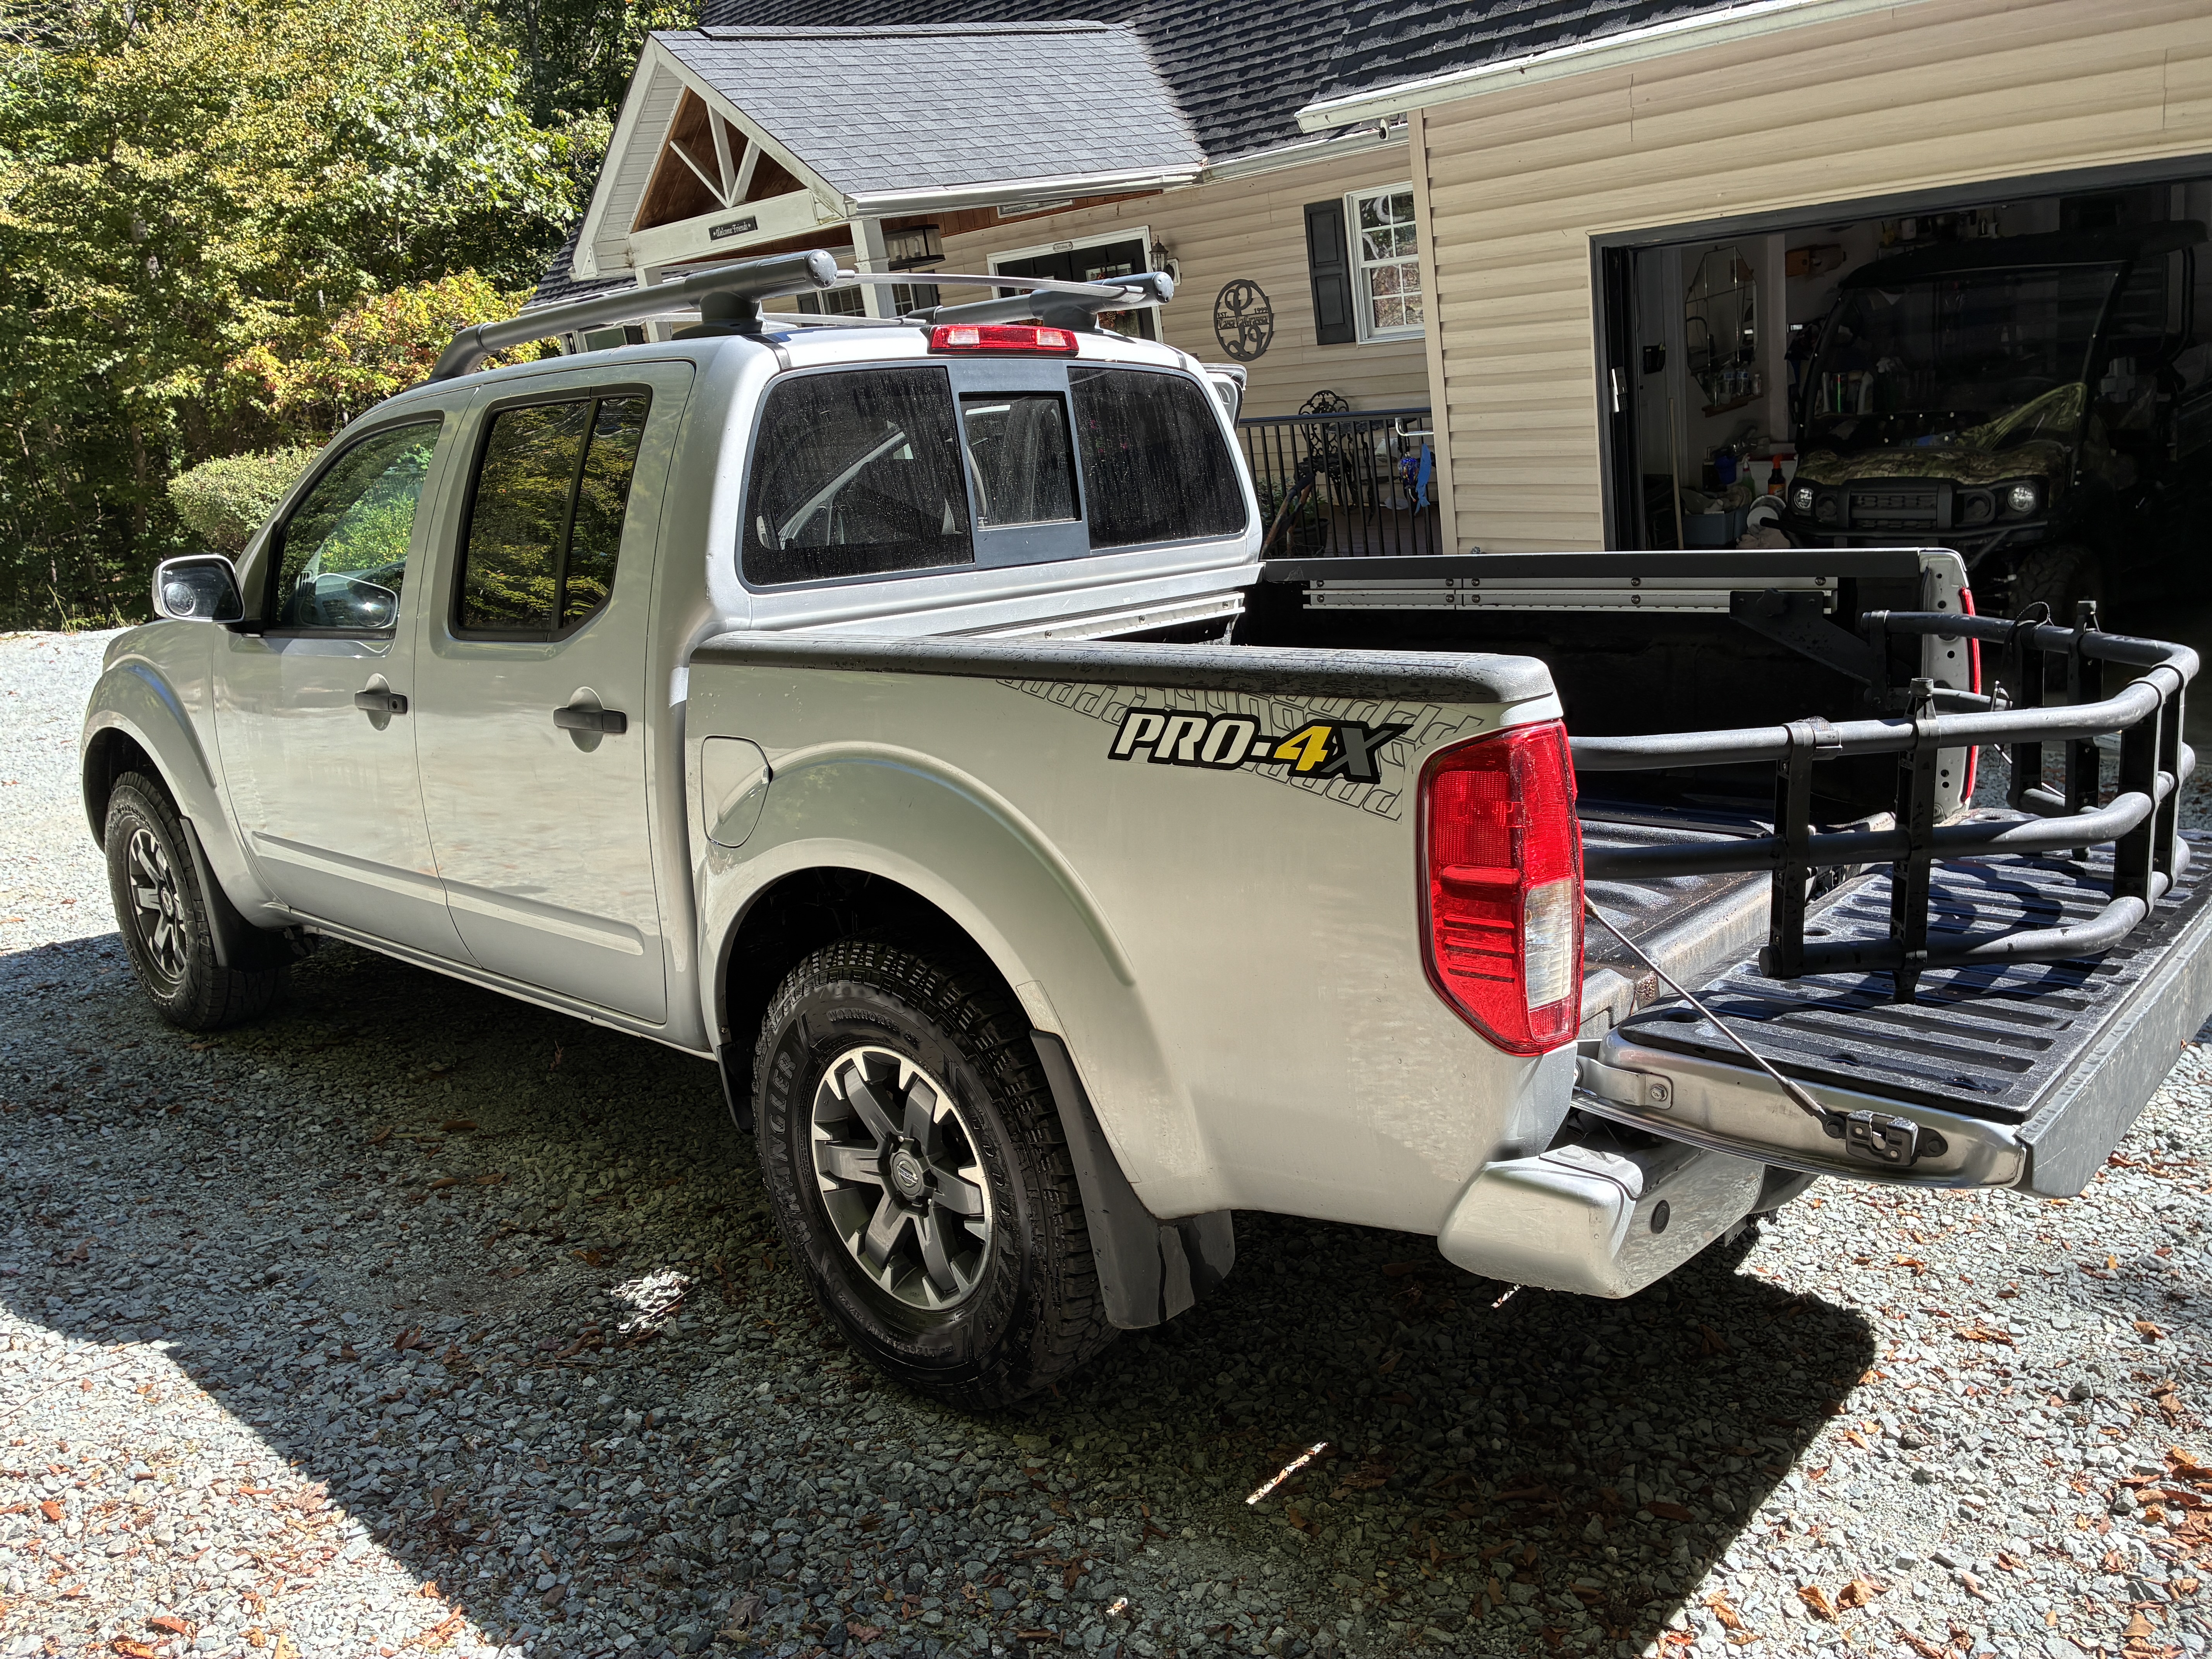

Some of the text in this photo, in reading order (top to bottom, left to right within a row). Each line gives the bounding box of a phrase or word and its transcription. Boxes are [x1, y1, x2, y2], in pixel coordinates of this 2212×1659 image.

[716, 222, 748, 237] Welcome Friends
[1114, 713, 1397, 778] PRO-4X
[827, 1008, 900, 1031] WORKHORSE
